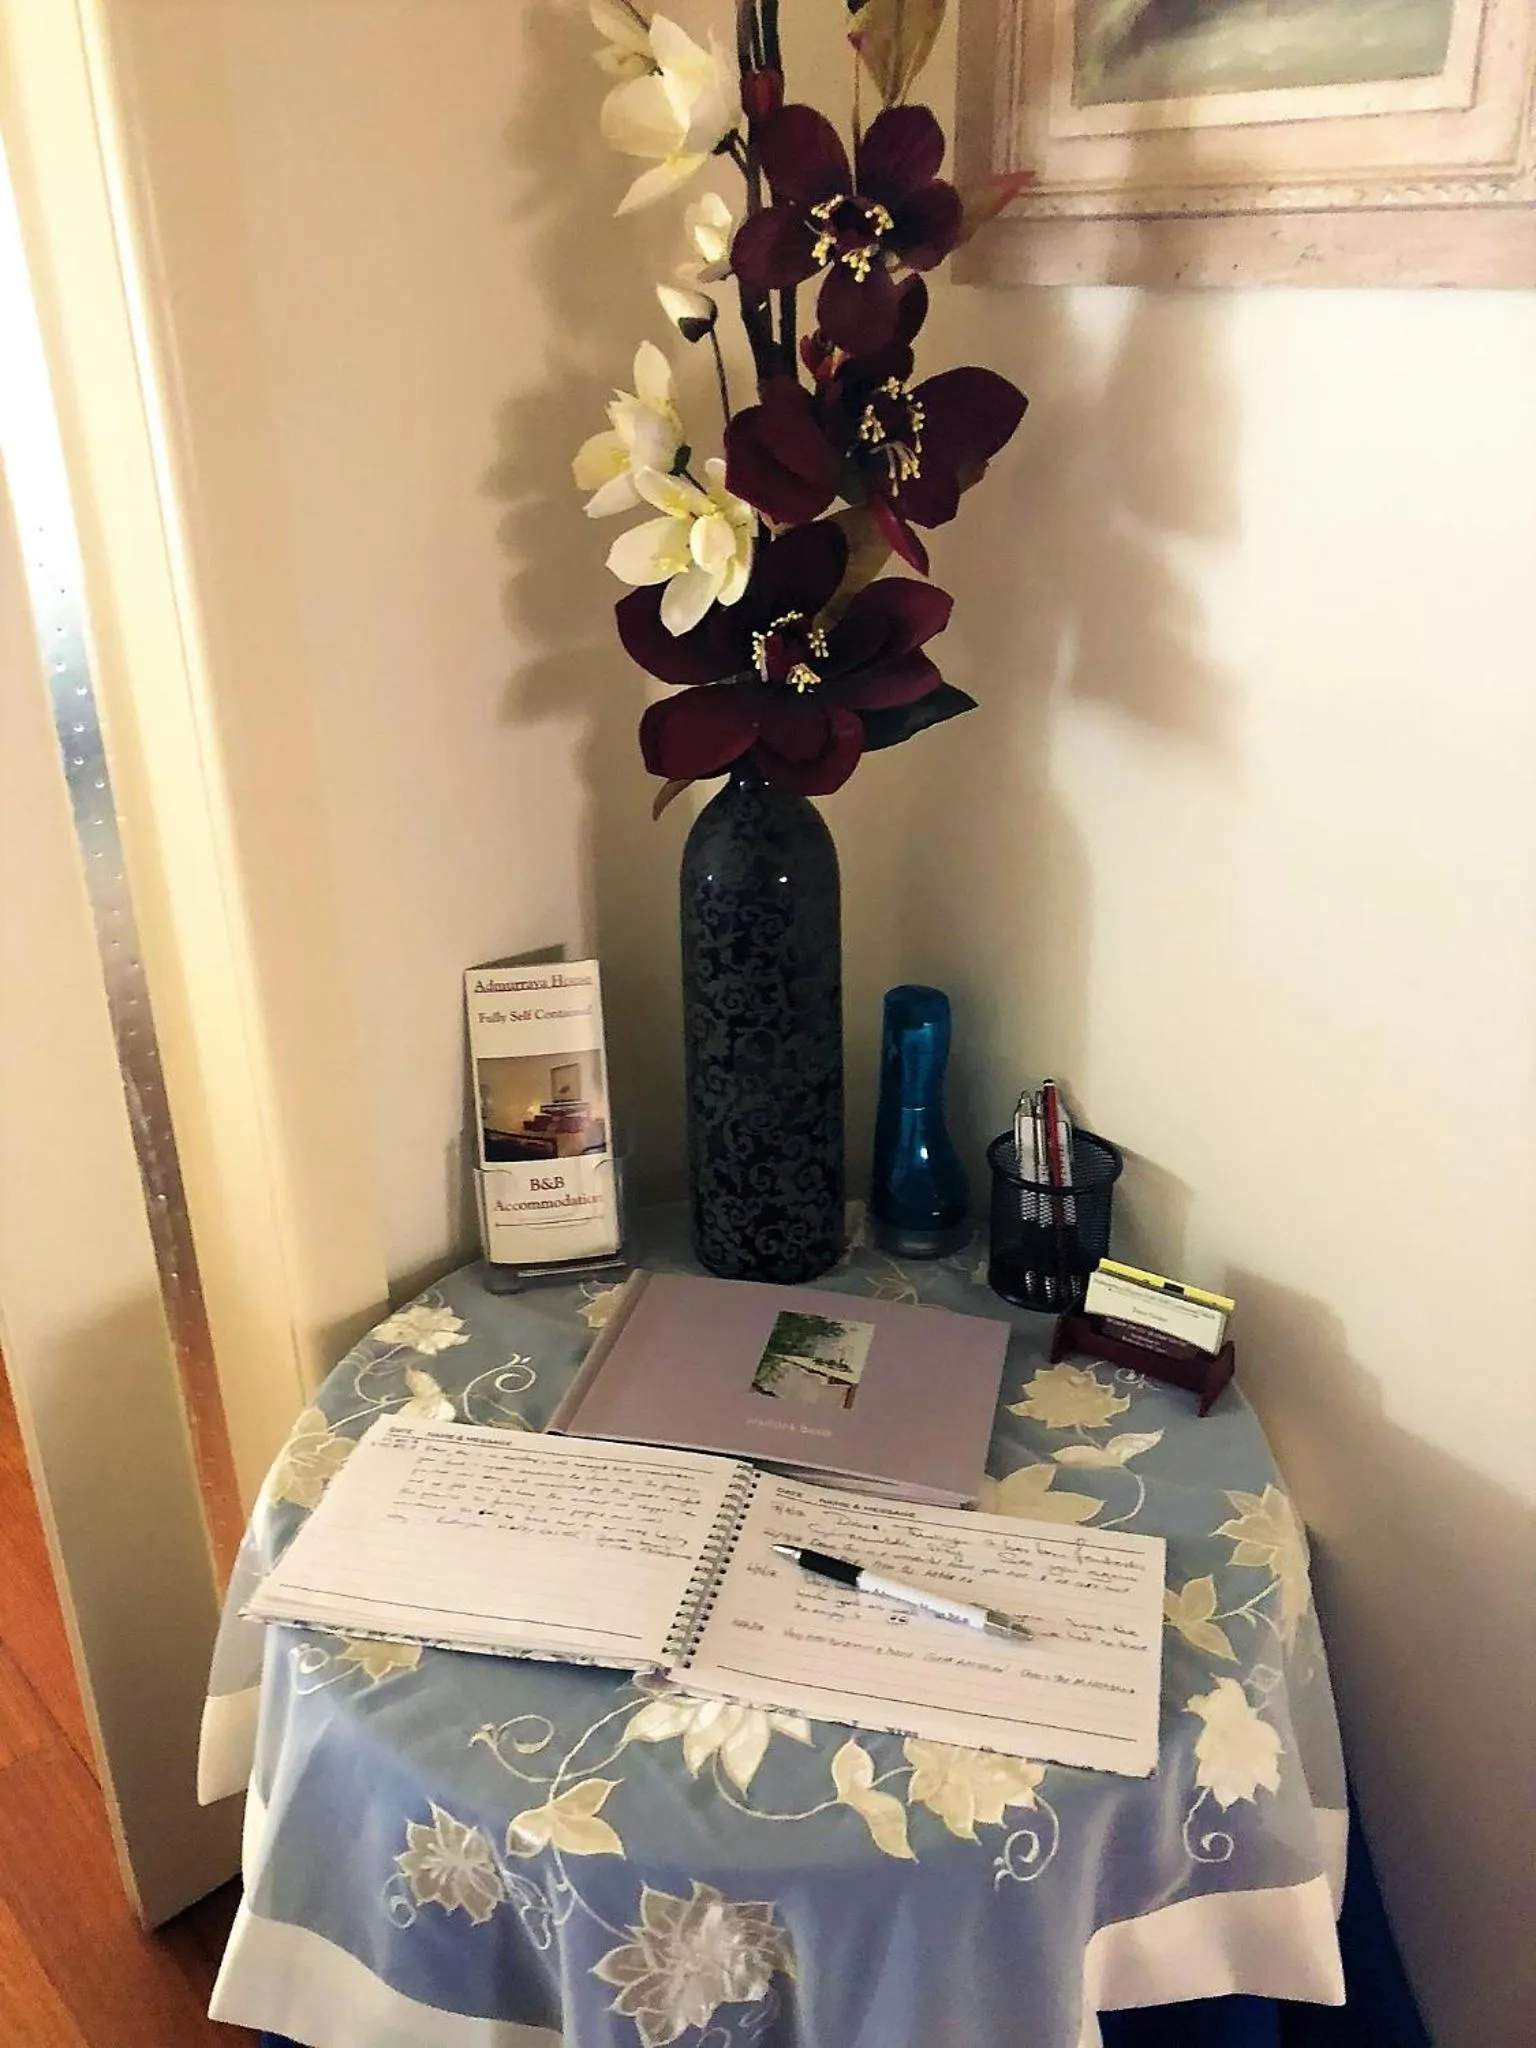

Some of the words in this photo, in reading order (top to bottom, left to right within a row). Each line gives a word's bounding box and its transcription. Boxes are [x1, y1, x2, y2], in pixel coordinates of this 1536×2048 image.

[477, 1010, 507, 1024] Fully
[510, 1009, 532, 1022] Self
[530, 1176, 565, 1192] B&B
[495, 1193, 603, 1213] Accommodation
